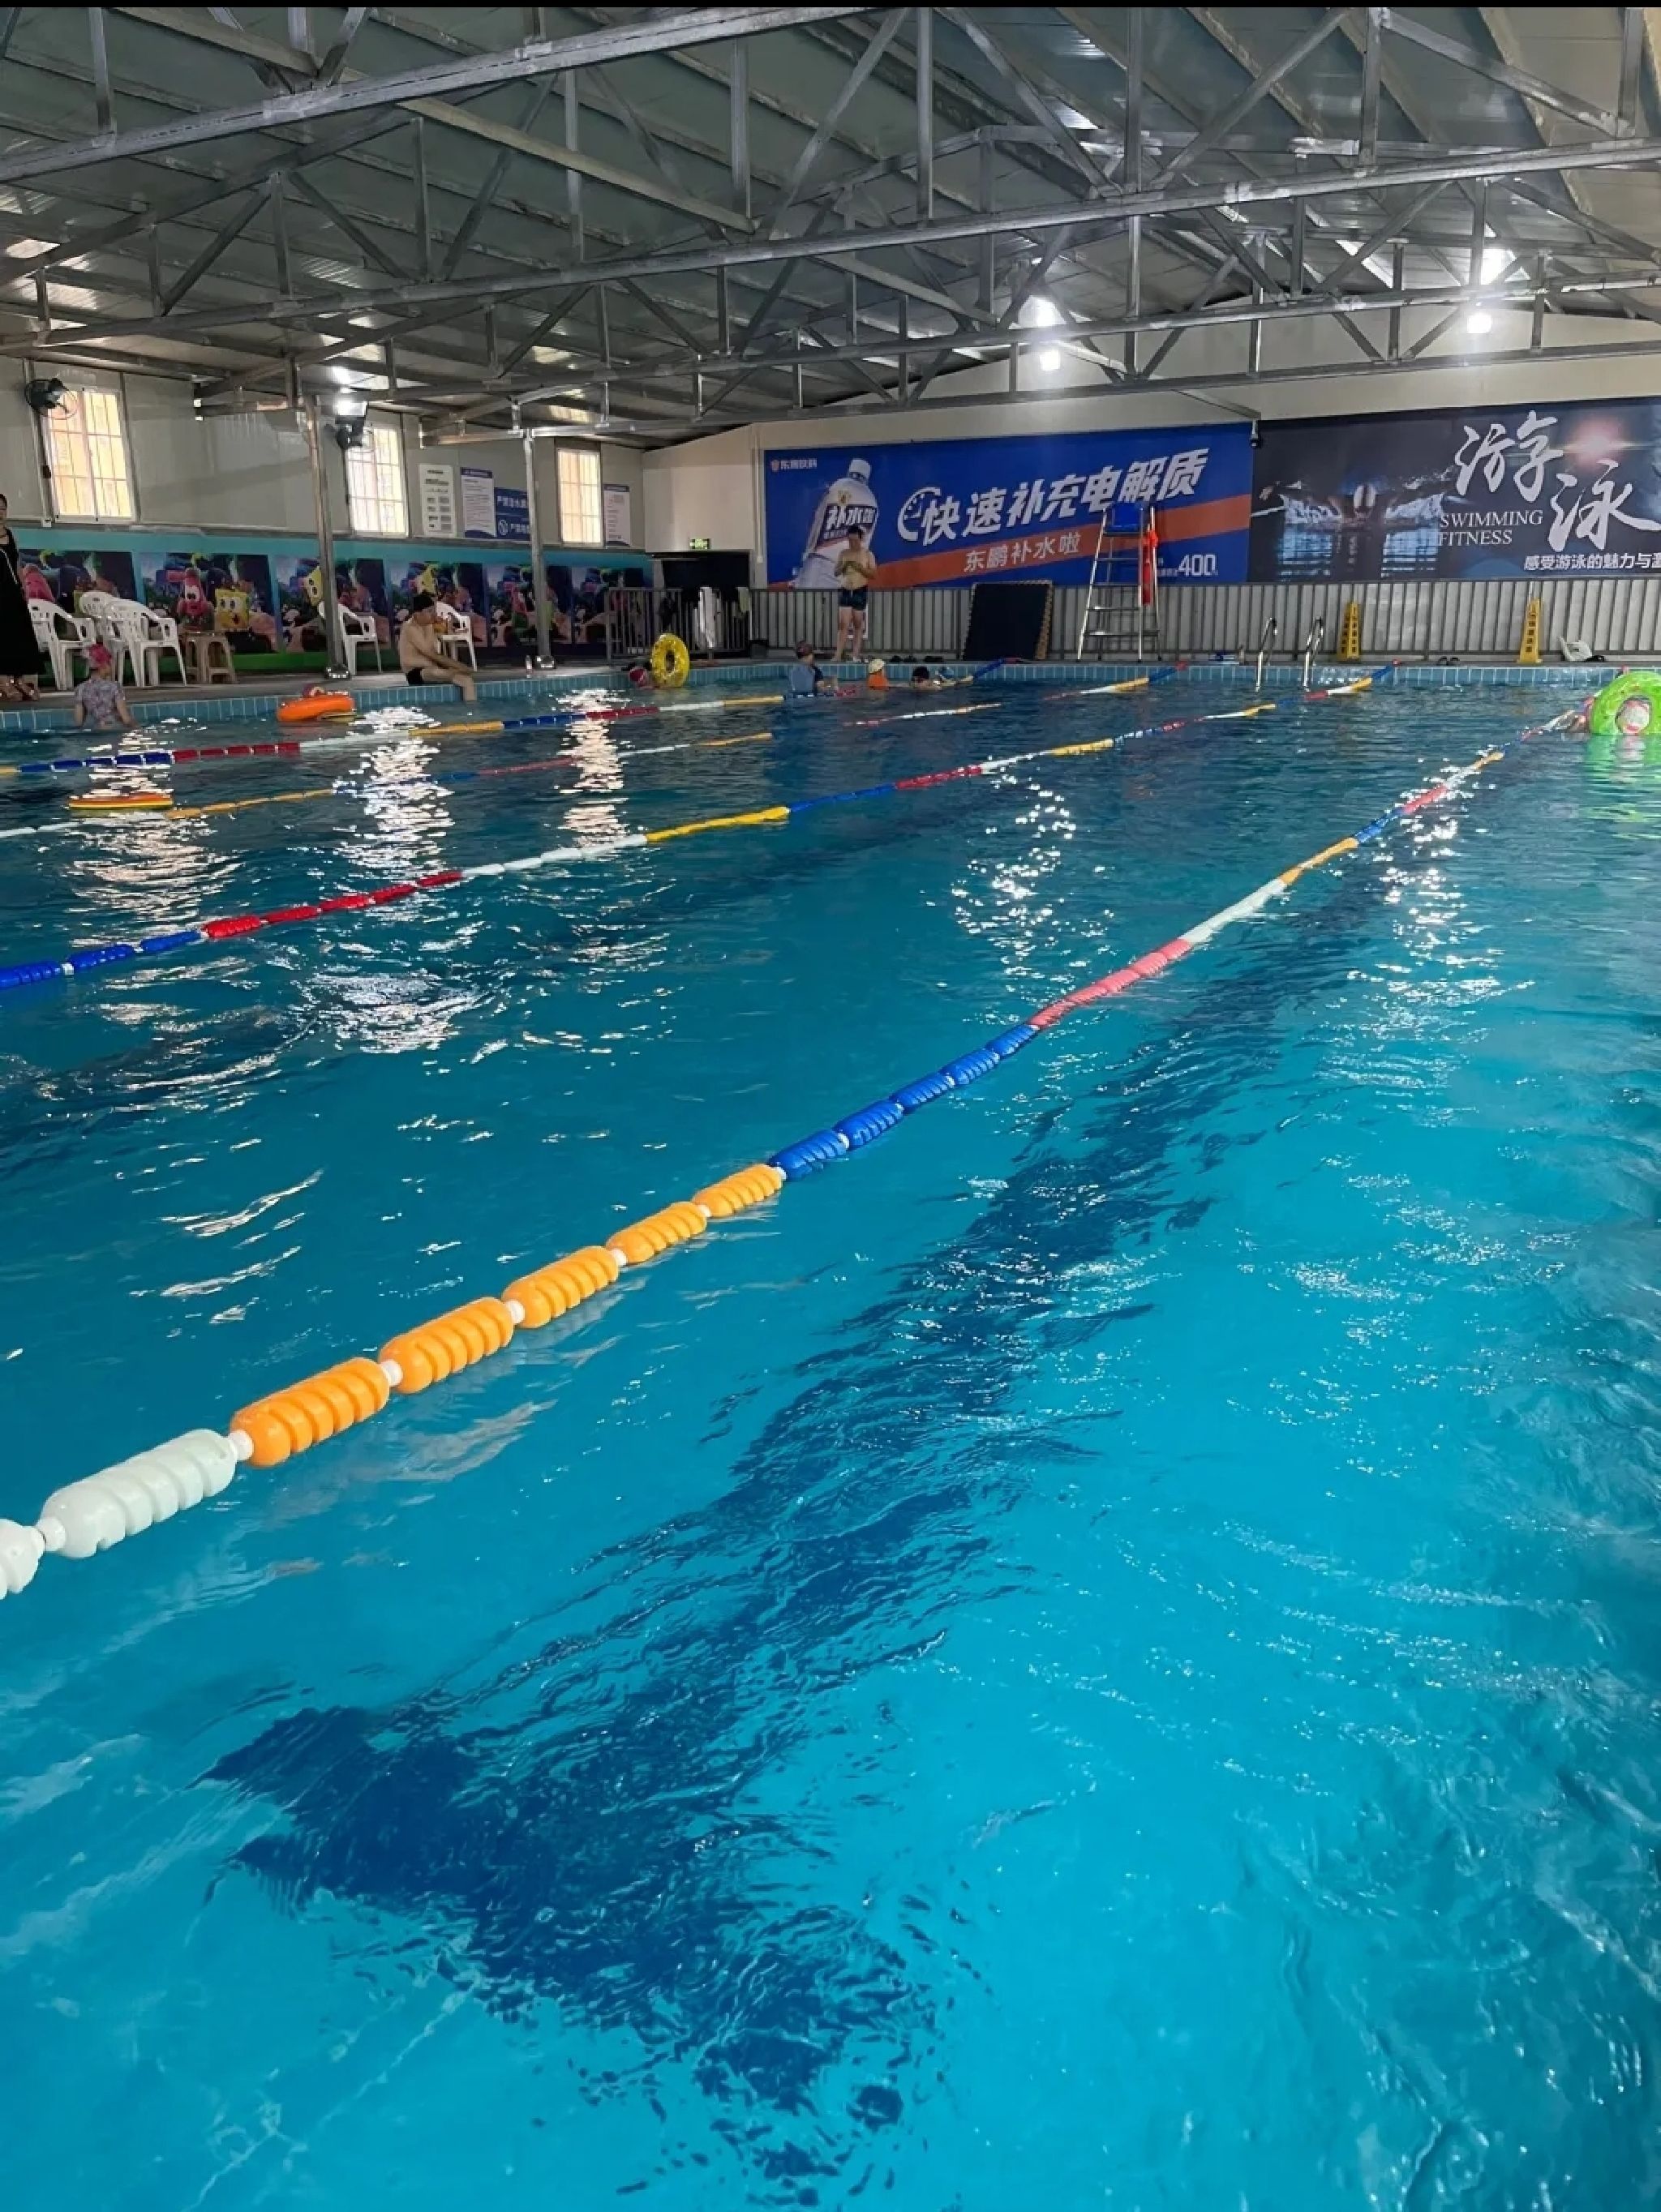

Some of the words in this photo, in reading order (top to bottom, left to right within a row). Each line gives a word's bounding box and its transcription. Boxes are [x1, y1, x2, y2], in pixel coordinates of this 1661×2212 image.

[921, 448, 1209, 546] 快速补充电解质
[1440, 510, 1543, 528] SWIMMING
[1438, 530, 1513, 547] FITNESS
[964, 531, 1082, 572] 东鹏补水啦
[1178, 554, 1216, 577] 400
